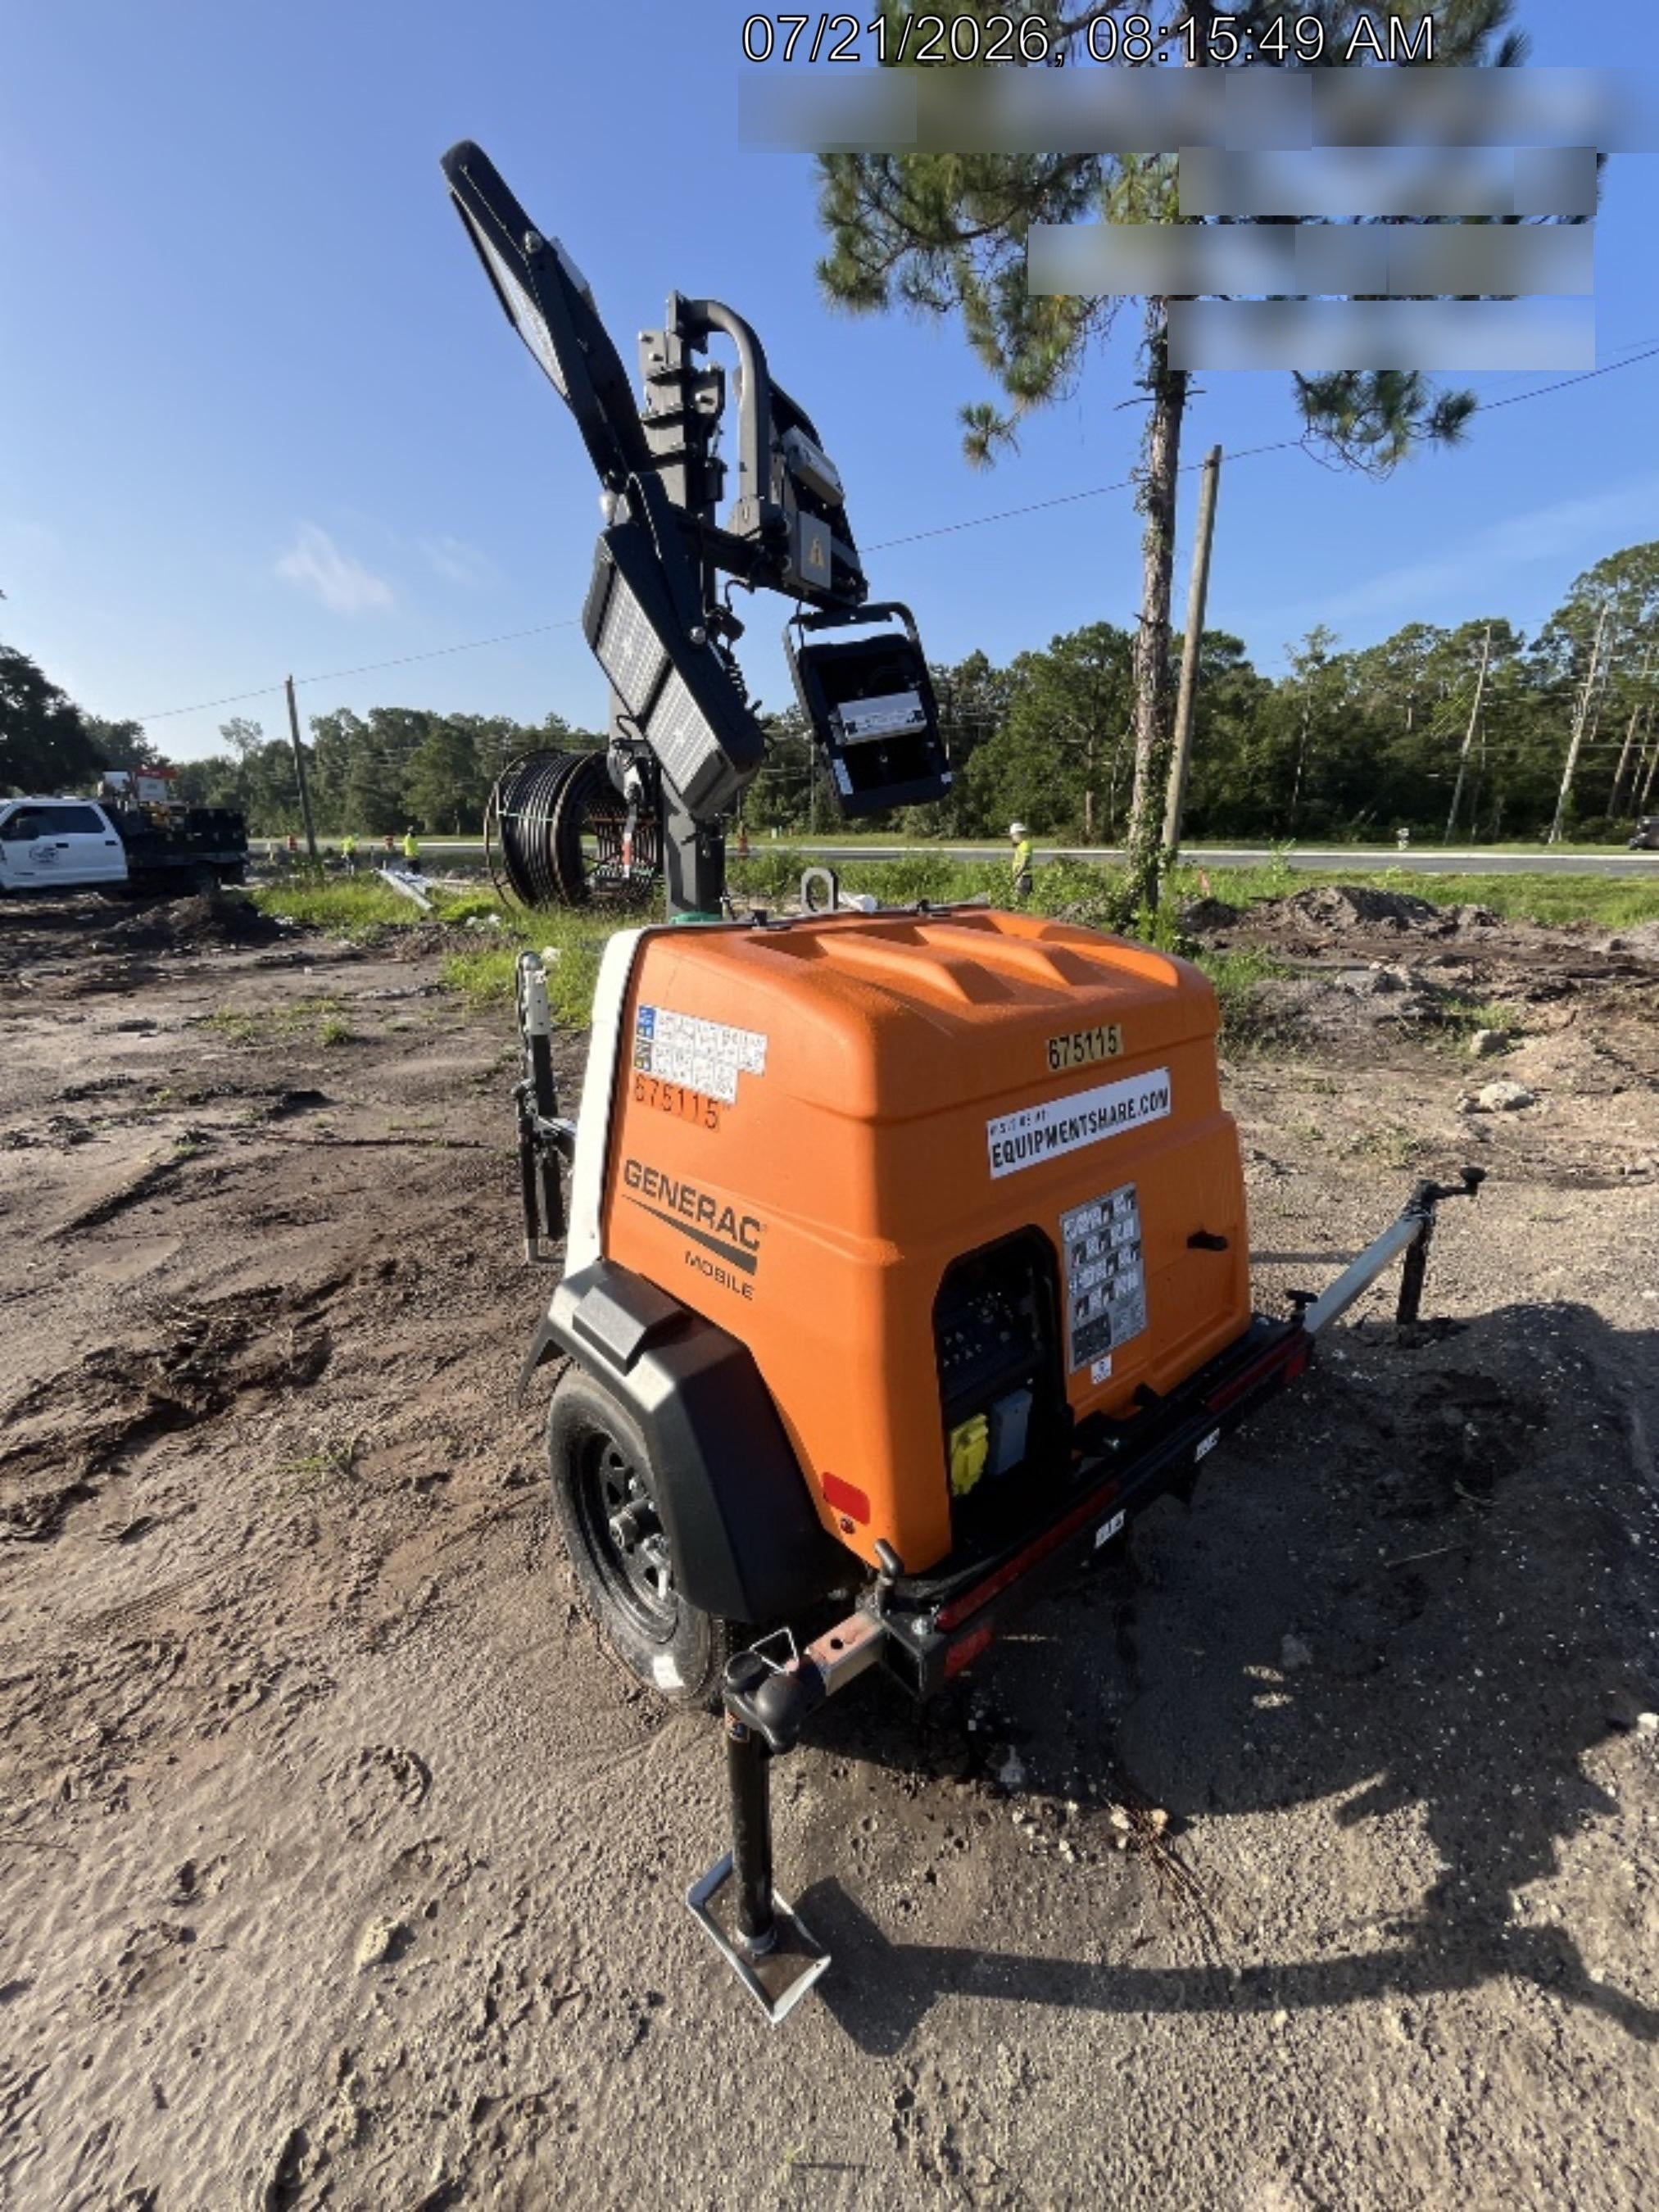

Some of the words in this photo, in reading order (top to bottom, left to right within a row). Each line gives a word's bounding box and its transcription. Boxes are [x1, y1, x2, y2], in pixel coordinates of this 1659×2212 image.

[1048, 1026, 1118, 1070] 675115
[634, 1074, 719, 1130] 675115
[992, 1086, 1169, 1168] EQUIPMENTSHARE.COM
[623, 1158, 761, 1252] GENERAC
[685, 1249, 755, 1301] MOBILE
